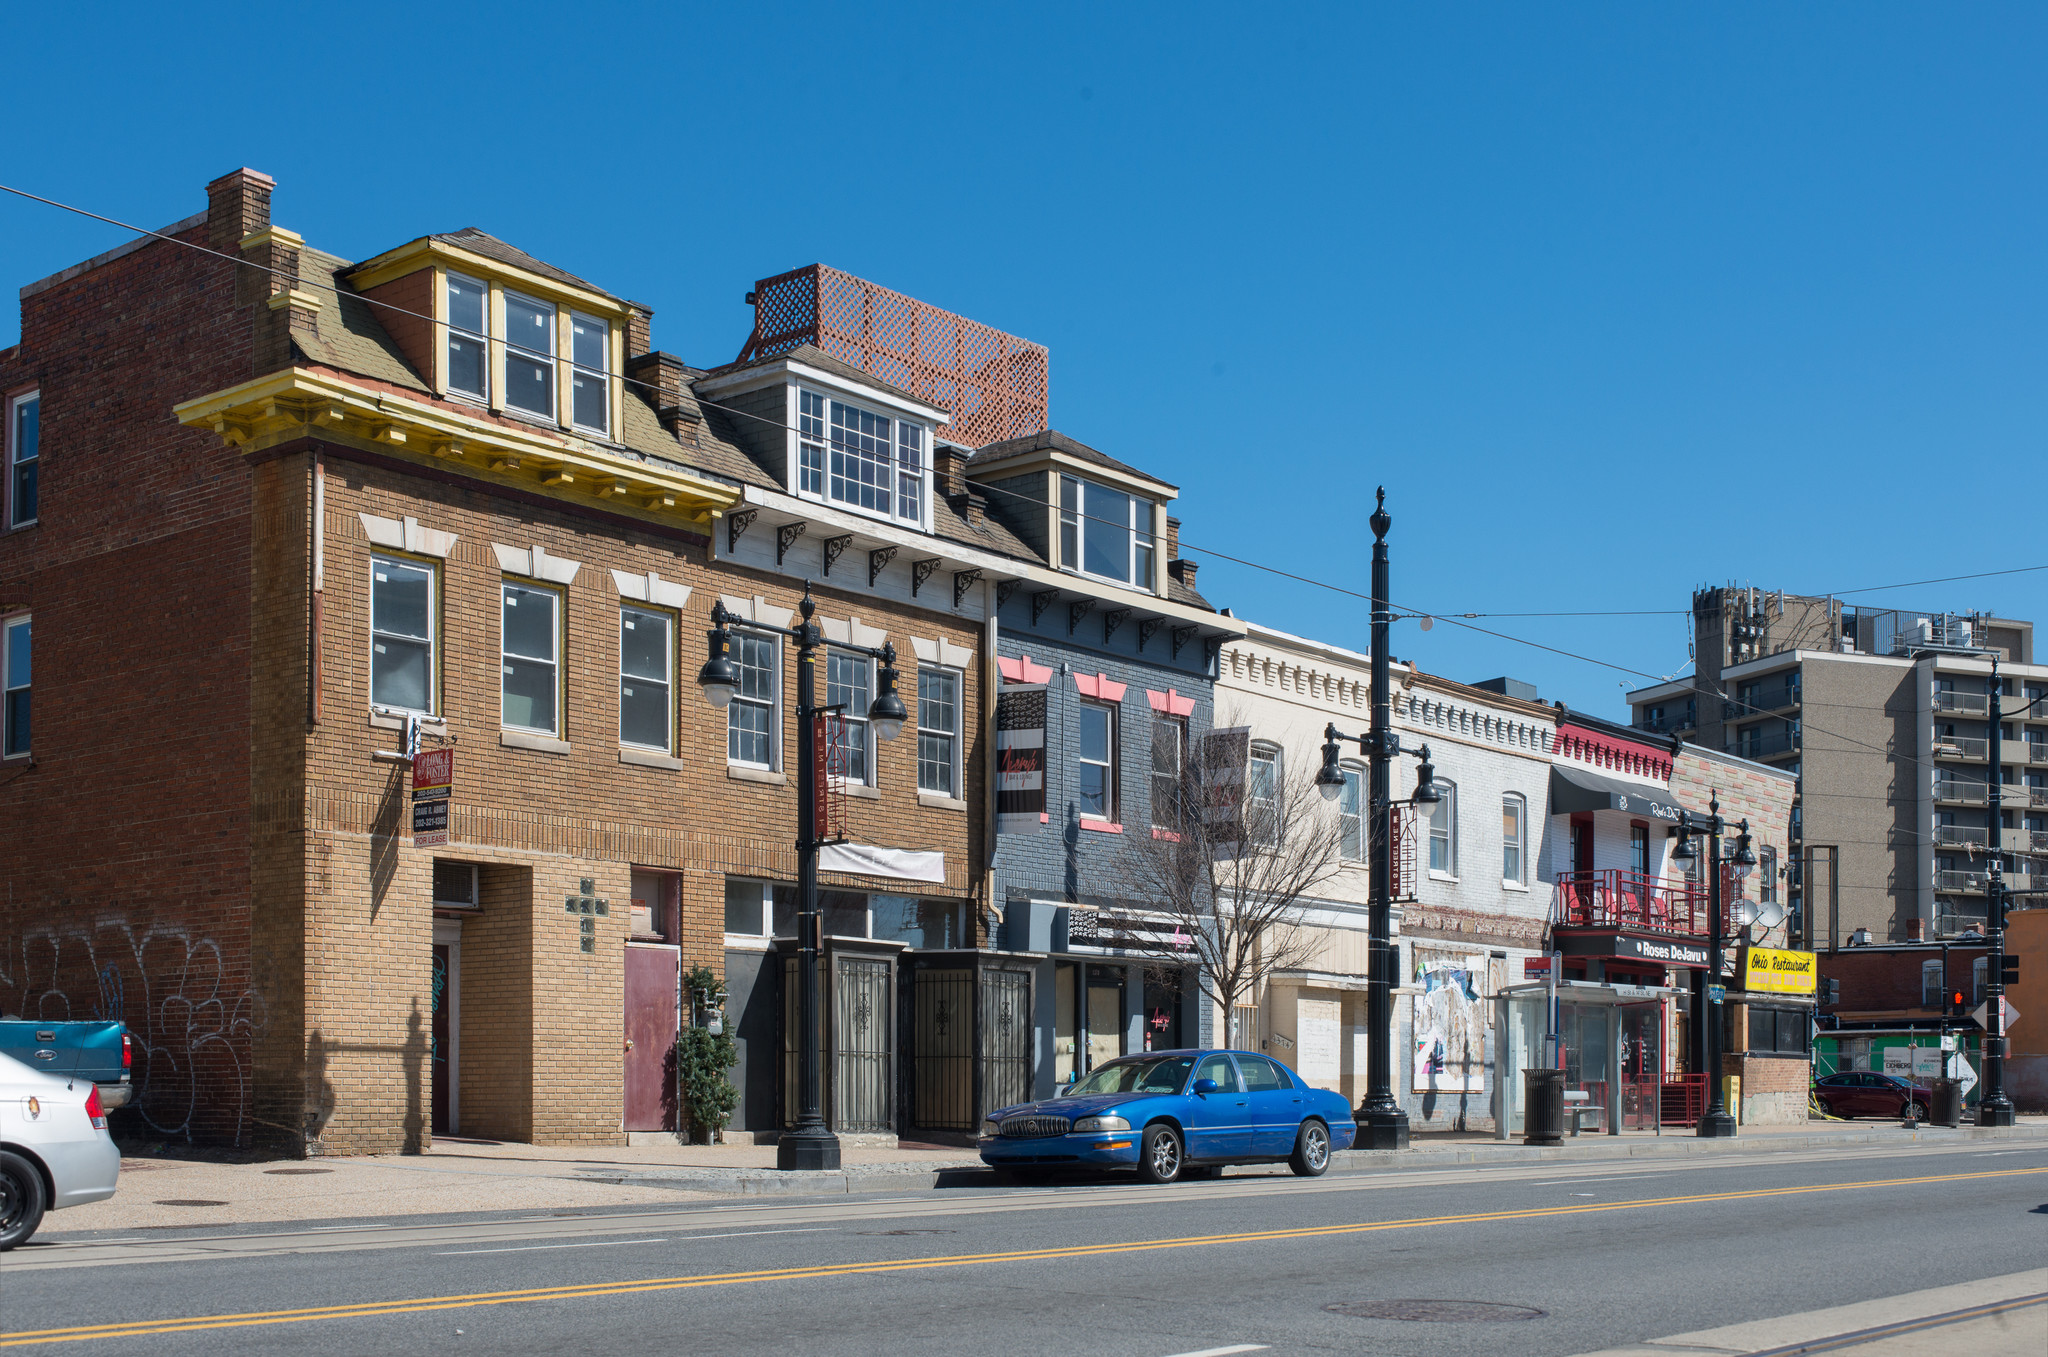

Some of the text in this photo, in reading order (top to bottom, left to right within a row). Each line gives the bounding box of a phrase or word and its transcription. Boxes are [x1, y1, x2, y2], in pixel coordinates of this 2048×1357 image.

[426, 751, 450, 766] LONG &
[426, 765, 450, 779] FOSTER
[415, 806, 428, 816] CRAIG
[415, 834, 446, 845] FOR LEASE
[1643, 941, 1702, 962] Roses DeJavu
[1751, 953, 1811, 973] Ohio Restaurant
